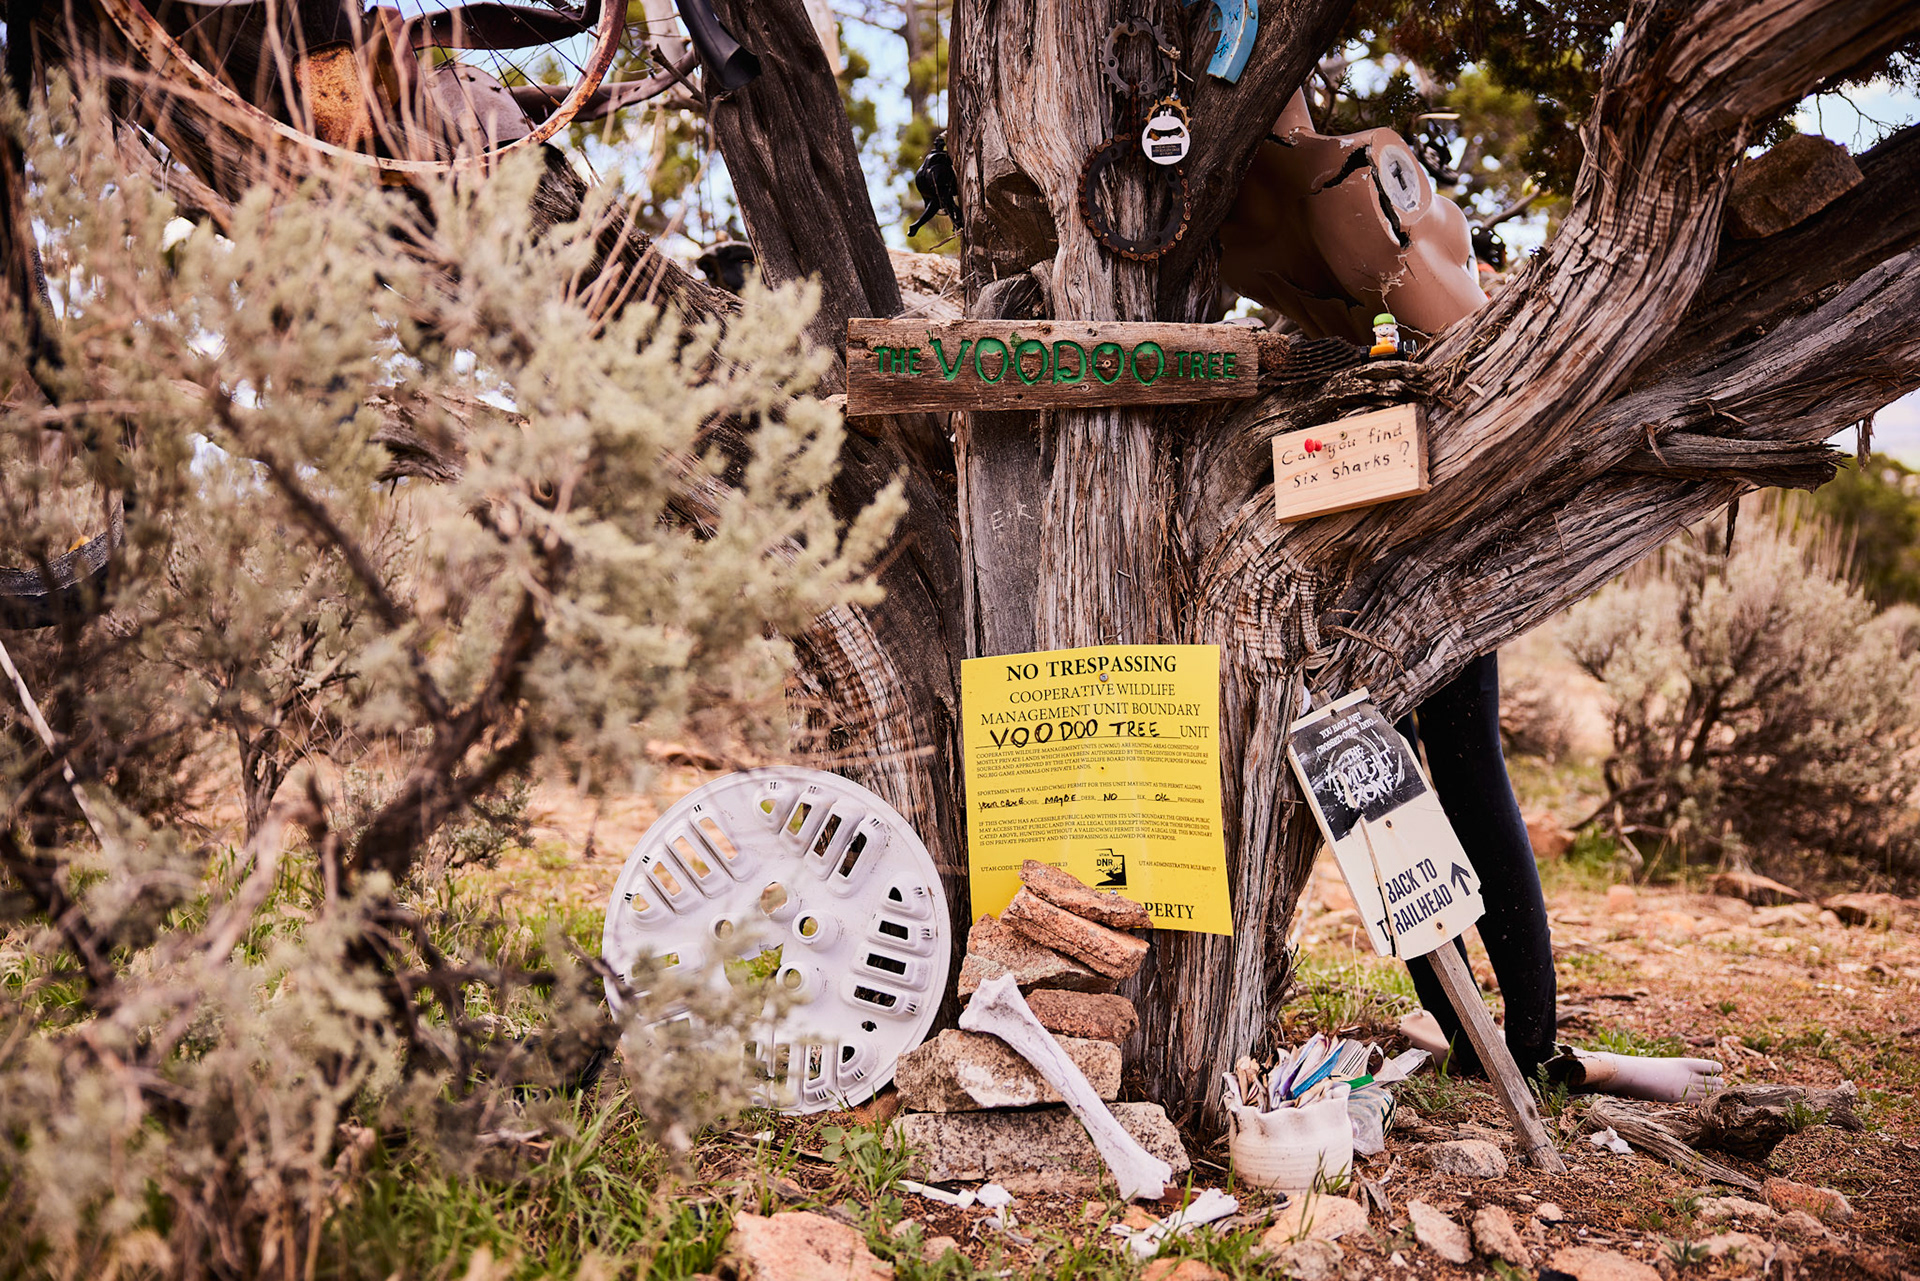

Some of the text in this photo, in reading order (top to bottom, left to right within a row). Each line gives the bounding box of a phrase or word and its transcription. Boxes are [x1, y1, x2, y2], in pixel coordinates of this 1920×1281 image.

[874, 330, 1239, 387] THE VOODOO TREE
[1282, 422, 1402, 465] Can you find
[1332, 454, 1390, 480] sharks
[1006, 655, 1177, 682] NO TRESPASSING
[1010, 683, 1175, 704] COOPERATIVE WILDLIFE
[980, 702, 1200, 726] MANAGEMENT UNIT BOUNDARY
[1319, 712, 1362, 739] YOU HAVE JUST
[990, 718, 1210, 750] VOODOO TREE UNIT
[1345, 744, 1364, 764] THE
[1326, 748, 1394, 800] TWILIGHT
[1104, 793, 1118, 801] NO
[1352, 774, 1394, 807] ZONE
[1096, 858, 1113, 866] DNR
[1385, 858, 1437, 904] BACK TO
[1144, 902, 1195, 919] PERTY
[1376, 883, 1453, 941] TRAILHEAD
